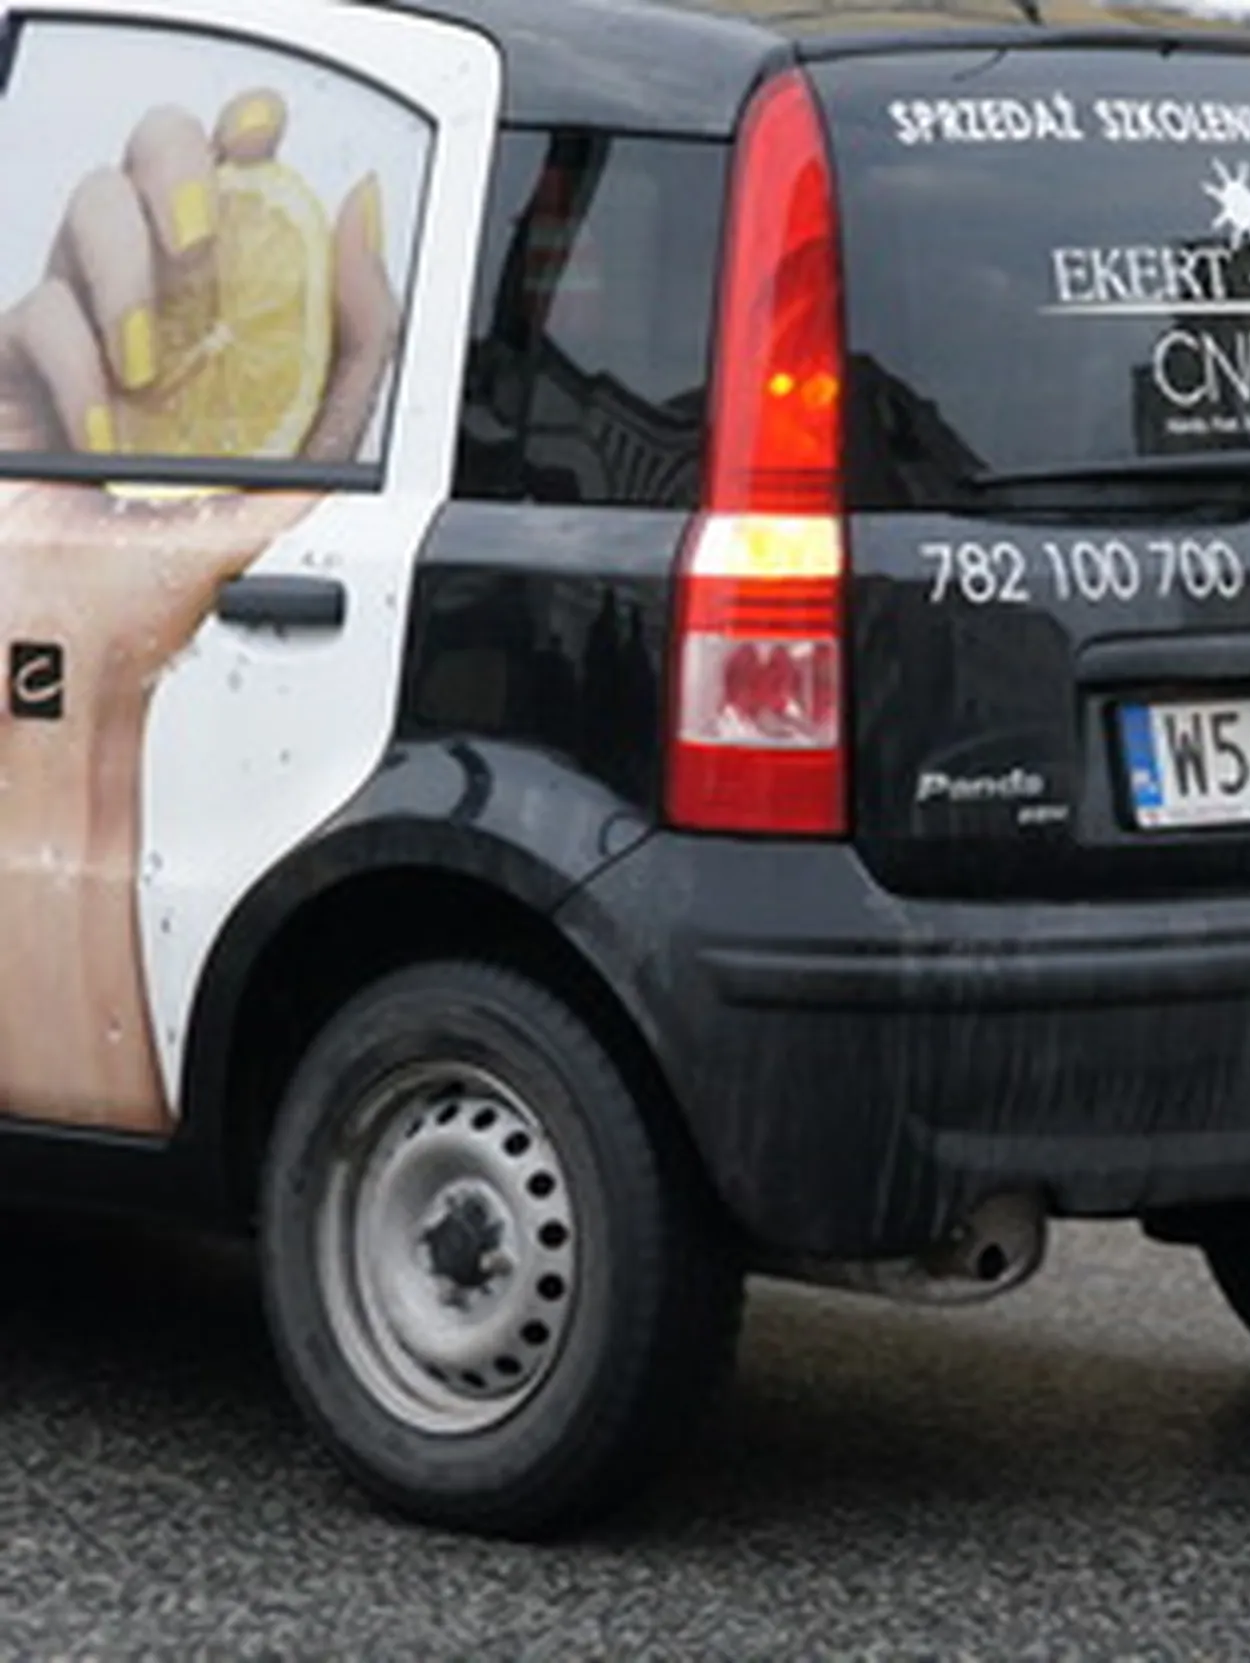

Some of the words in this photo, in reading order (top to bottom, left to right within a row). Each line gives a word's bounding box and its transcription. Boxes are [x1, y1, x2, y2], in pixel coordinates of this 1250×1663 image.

[889, 91, 1083, 144] SPRZEDAŻ
[1053, 248, 1229, 301] EKERT
[921, 543, 1028, 604] 782
[1043, 543, 1140, 600] 100
[1145, 540, 1244, 598] 700
[1164, 711, 1250, 797] W5
